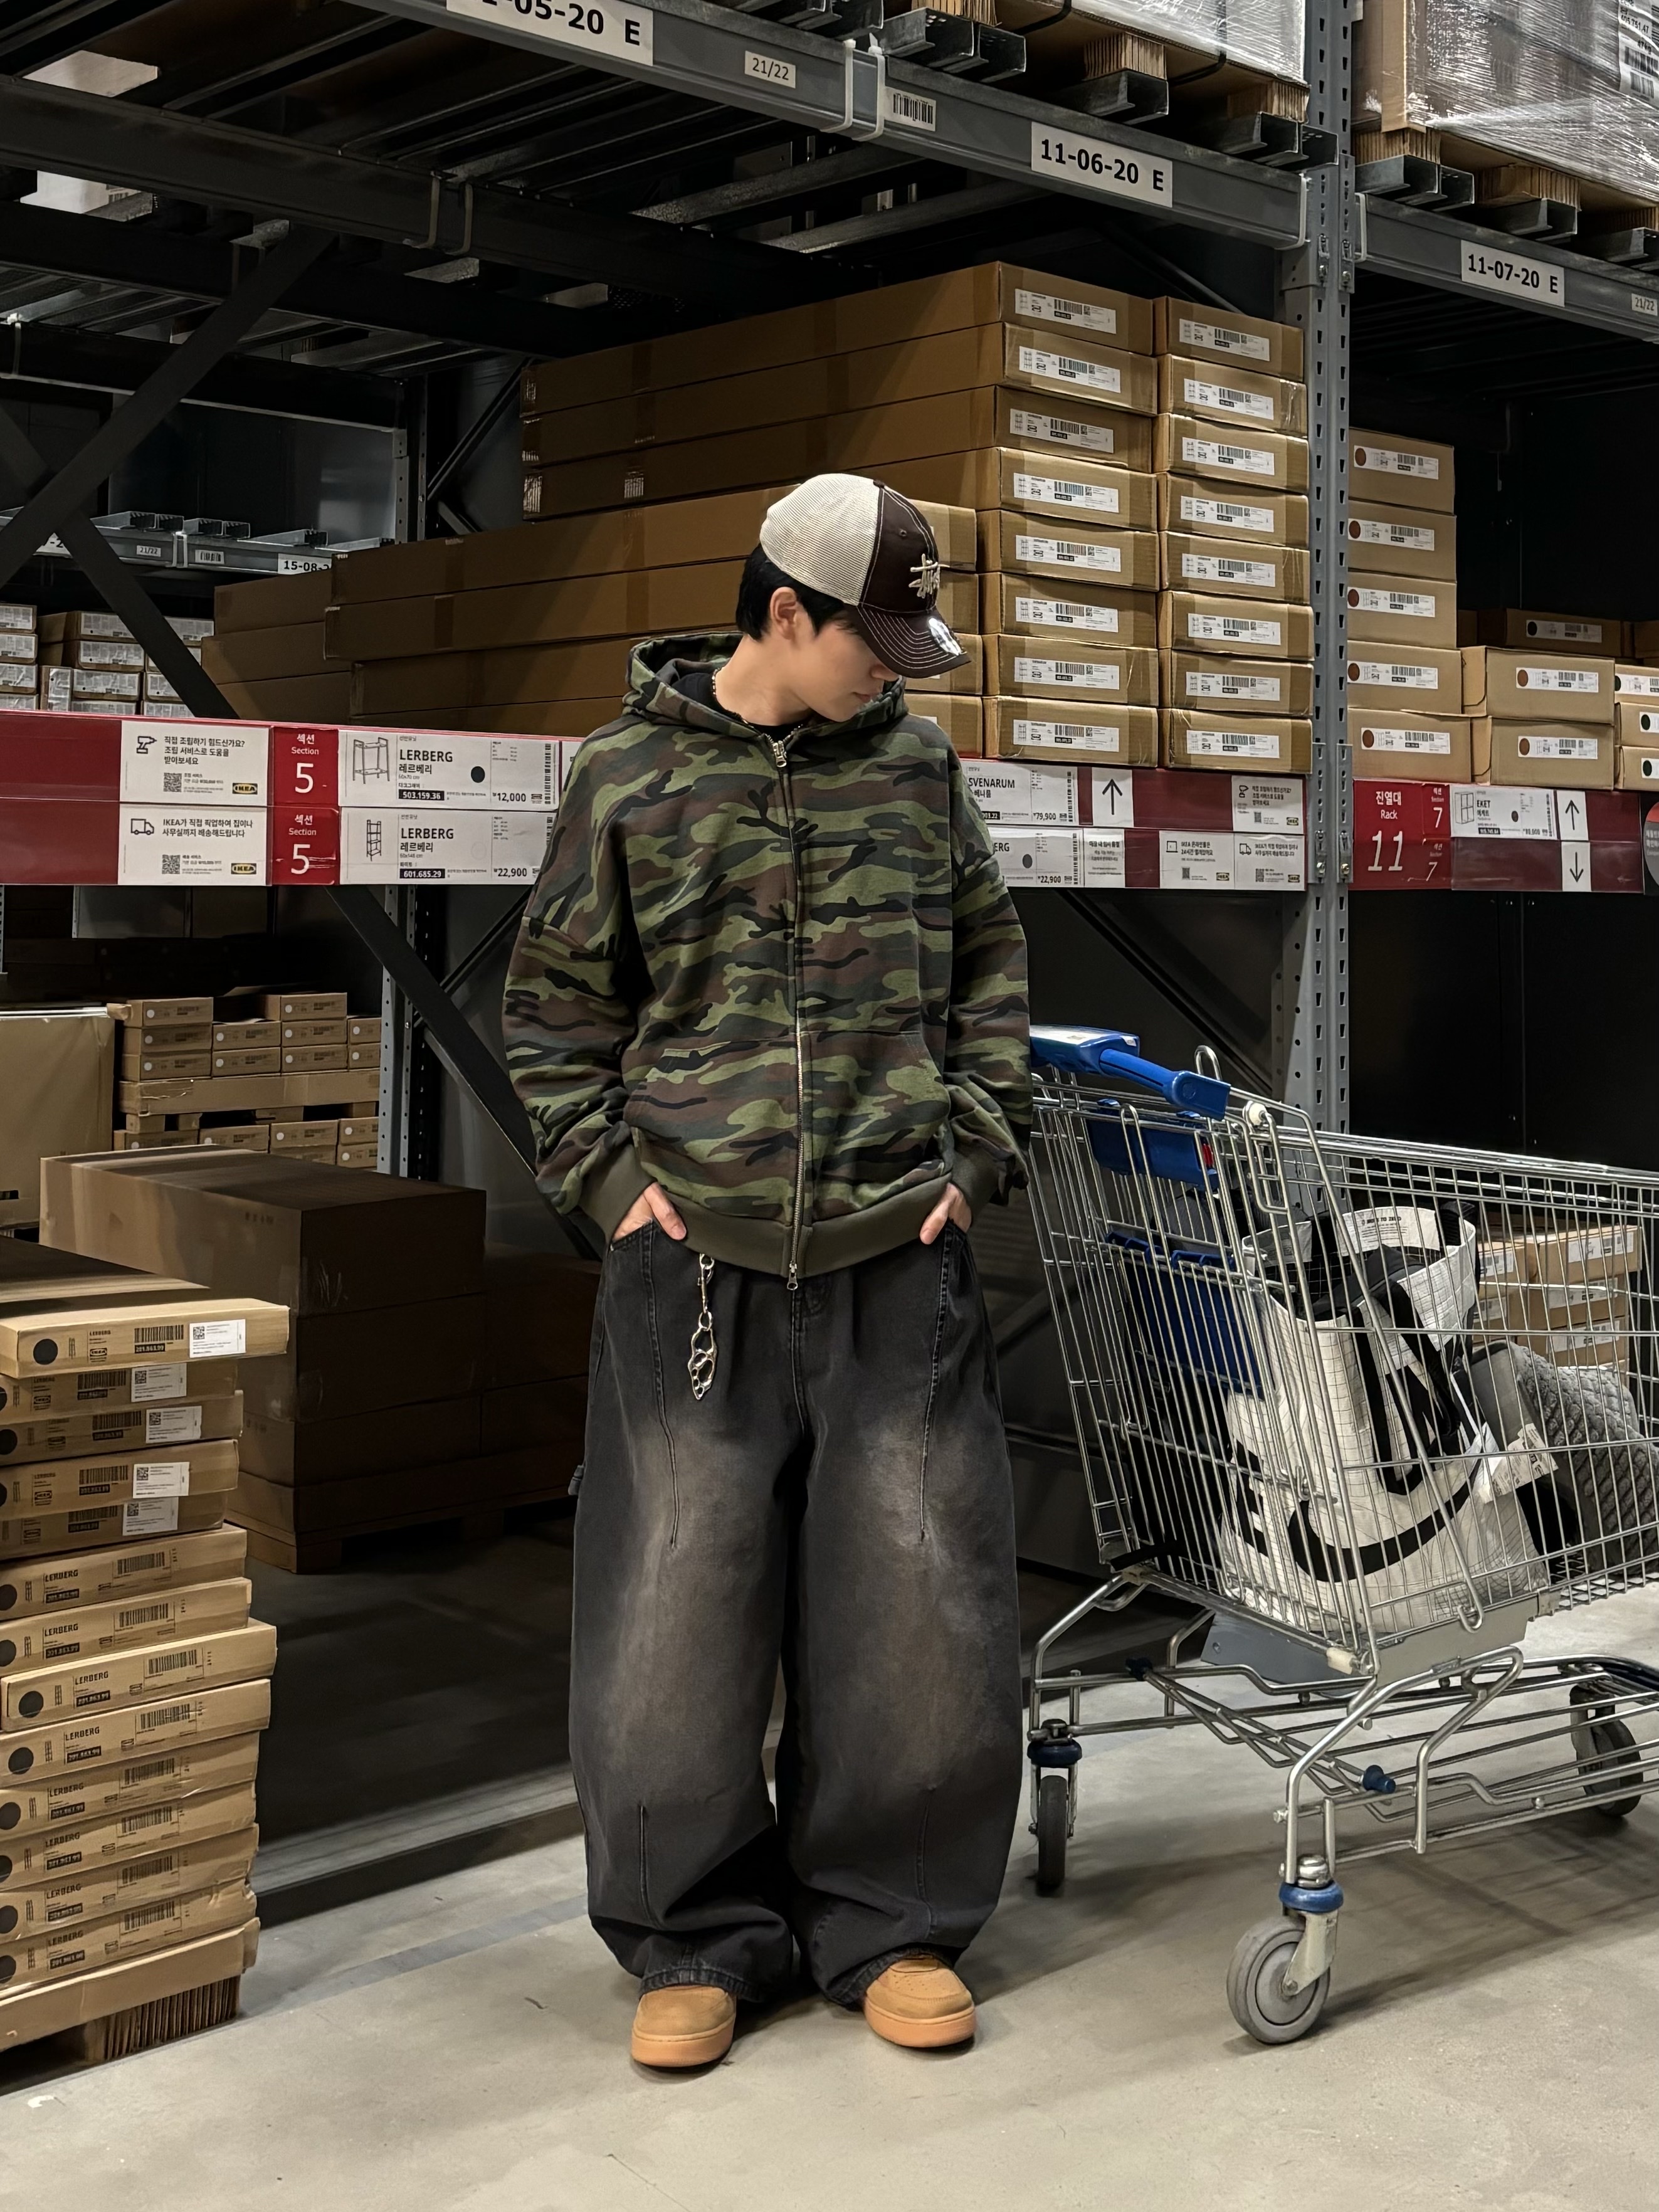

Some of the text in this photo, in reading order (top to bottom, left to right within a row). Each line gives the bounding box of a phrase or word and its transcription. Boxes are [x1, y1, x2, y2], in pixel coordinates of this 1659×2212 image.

[482, 0, 640, 46] -05-20 E
[752, 57, 789, 81] 21/22
[1041, 139, 1164, 191] 11-06-20 E
[1468, 254, 1558, 293] 11-07-20 E
[1634, 297, 1655, 311] 21/22
[139, 547, 158, 555] 21/22
[164, 736, 245, 747] 직접 조립하기 힘드신가요?
[297, 734, 315, 745] 섹션
[180, 747, 208, 756] 서비스로
[209, 748, 229, 757] 도움을
[291, 747, 319, 755] Section
[399, 749, 453, 762] LERBERG
[164, 756, 199, 765] 받아보세요
[399, 764, 432, 774] 레르베리
[295, 762, 314, 794] 5
[968, 777, 1015, 788] SVENARUM
[403, 791, 441, 800] 503.159.36
[1376, 791, 1402, 806] 진열대
[1477, 800, 1491, 808] EKET
[294, 814, 313, 826] 섹션
[1380, 809, 1398, 819] Rack
[1433, 807, 1443, 828] 7
[163, 819, 253, 828] IKEA가 직접 픽업하여 집이나
[162, 829, 245, 838] 사무실까지 배송해드립니다
[288, 828, 317, 836] Section
[401, 828, 454, 840] LERBERG
[400, 842, 433, 853] 레르베리
[1367, 830, 1403, 872] 11
[291, 843, 310, 875] 5
[1426, 861, 1438, 881] 7
[45, 1569, 78, 1582] LERBERG
[45, 1623, 78, 1636] LERBERG
[75, 1671, 108, 1685] LERBERG
[65, 1726, 100, 1741] LERBERG
[49, 1783, 84, 1797] LERBERG
[45, 1832, 80, 1848] LERBERG
[46, 1883, 82, 1899] LERBERG
[48, 1930, 83, 1946] LERBERG
